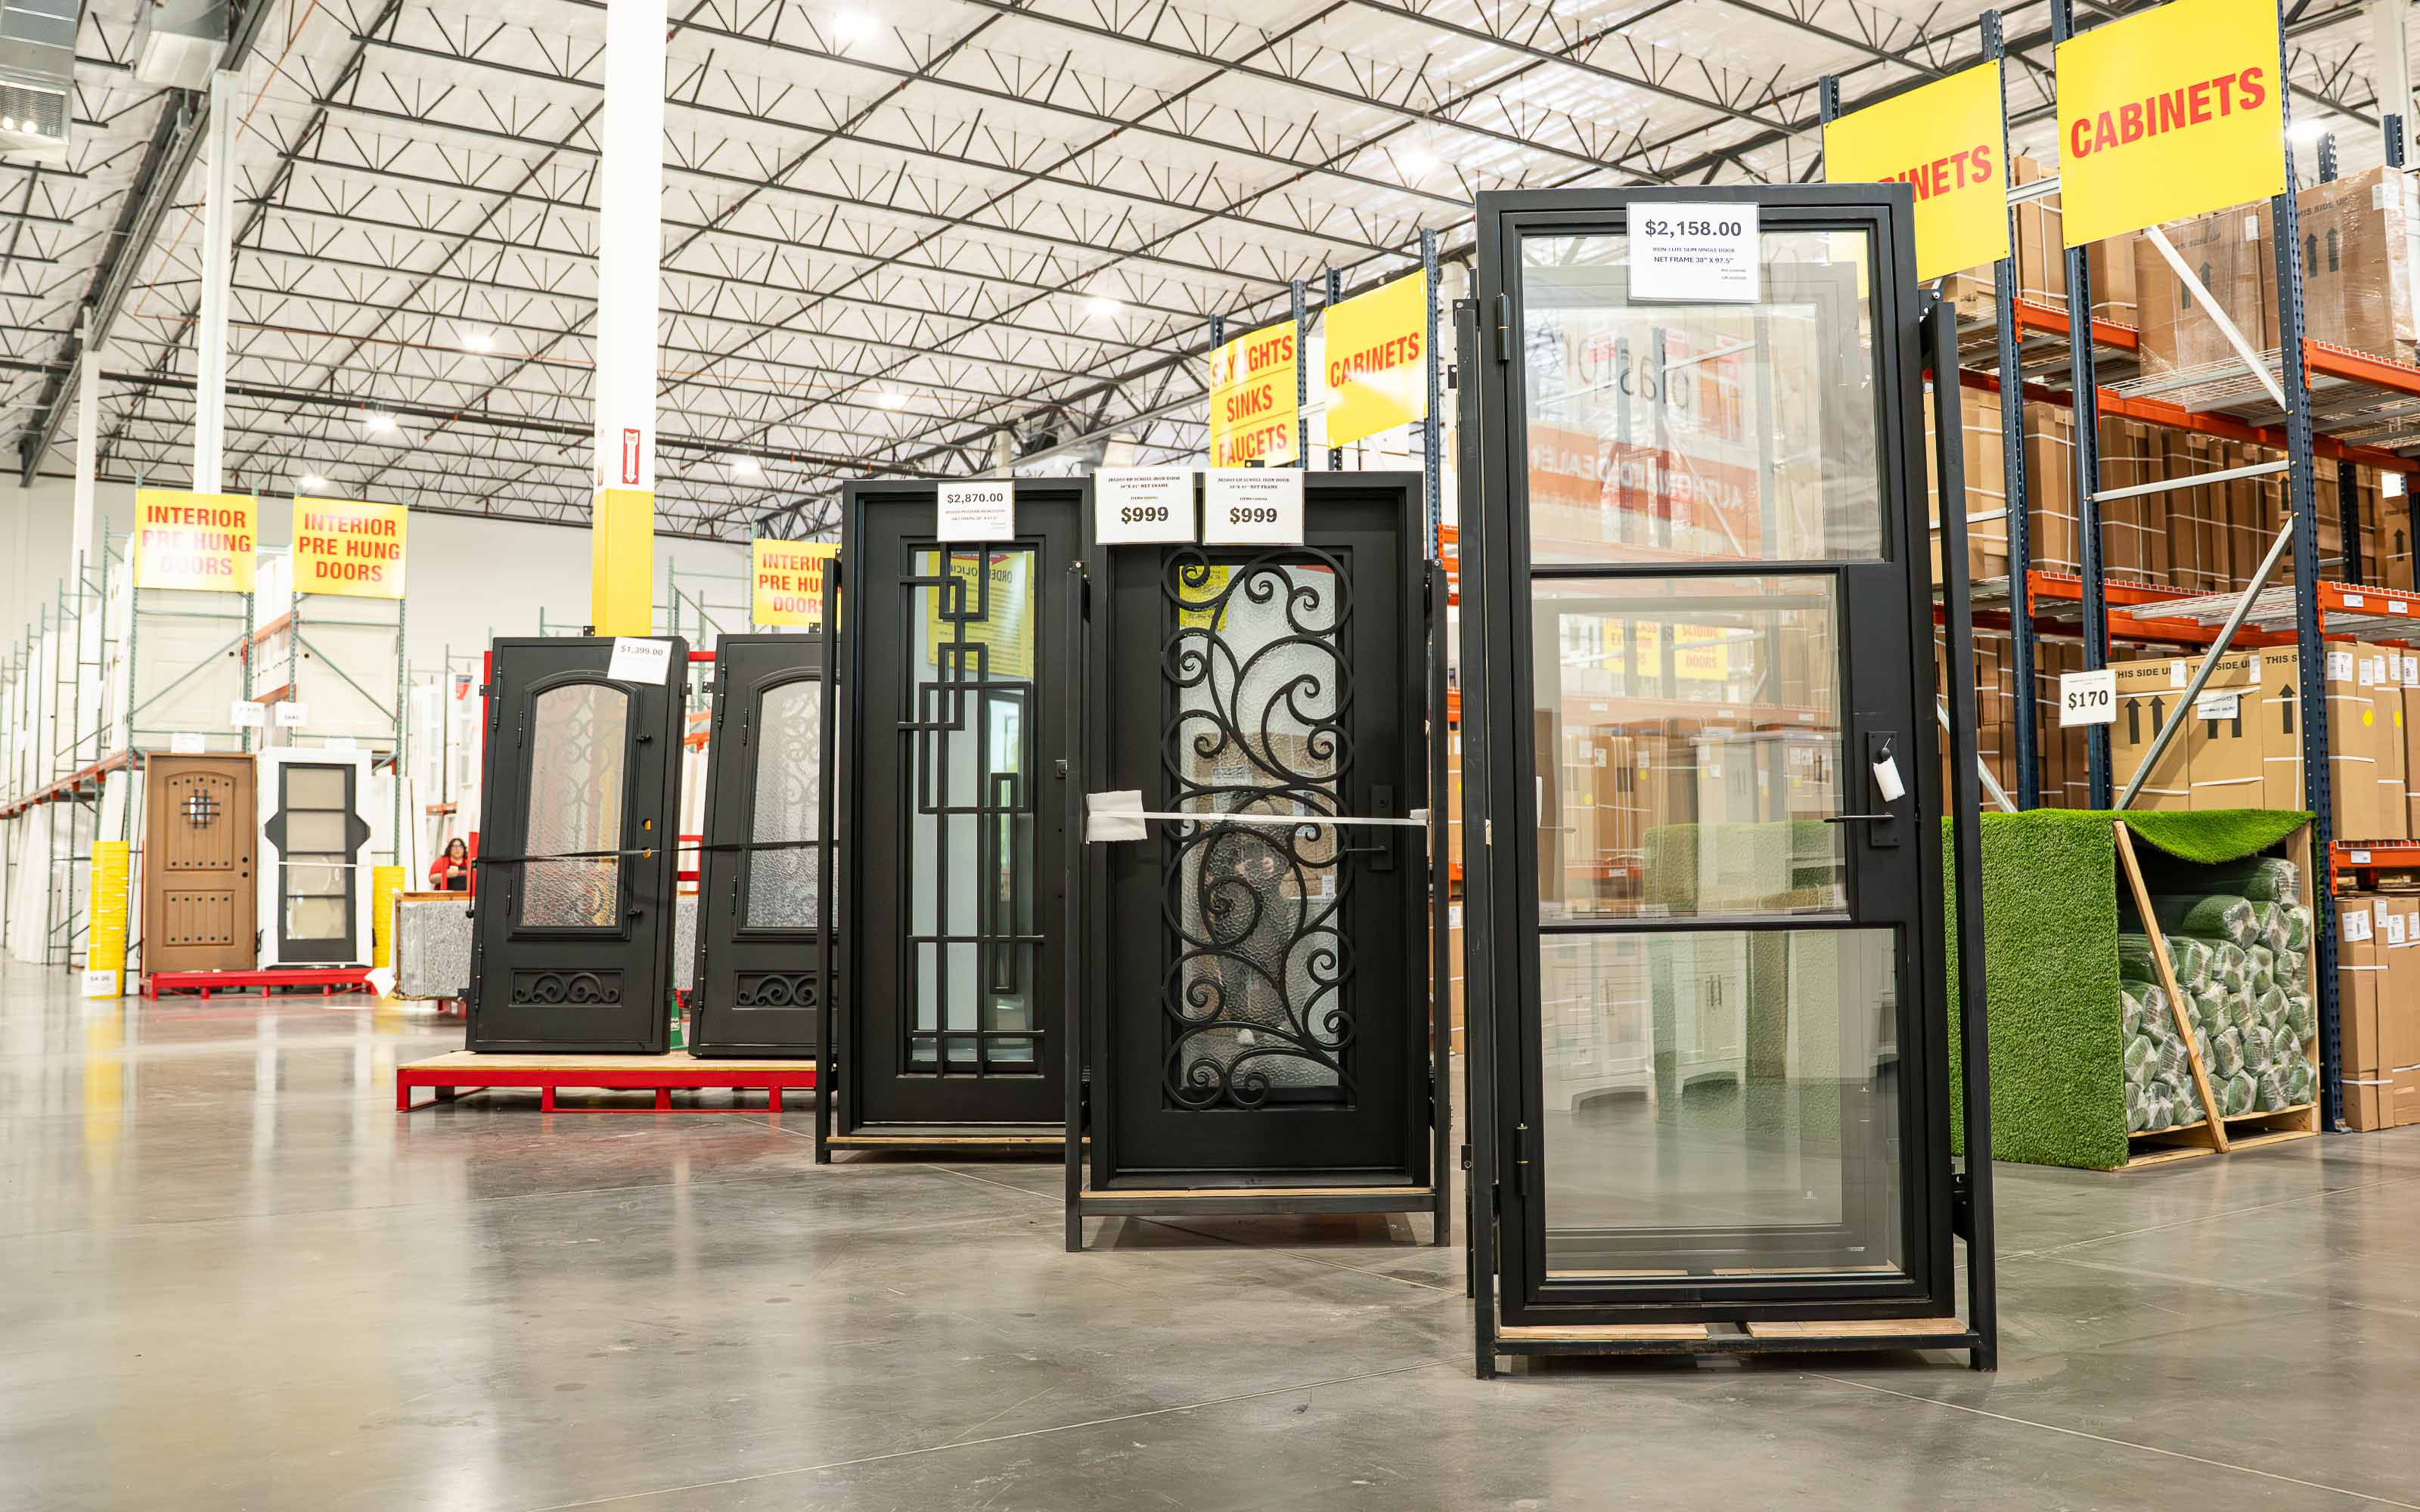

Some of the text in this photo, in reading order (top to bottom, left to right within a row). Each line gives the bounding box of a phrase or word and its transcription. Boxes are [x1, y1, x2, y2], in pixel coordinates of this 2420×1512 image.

[2071, 67, 2266, 159] CABINETS
[1877, 144, 1993, 203] NETS
[1645, 218, 1742, 238] $2,158.00
[1330, 332, 1419, 388] CABINETS
[1227, 384, 1273, 423] SINKS
[1219, 423, 1287, 467] FAUCETS
[947, 493, 1004, 504] $2,870.00
[147, 505, 247, 528] INTERIOR
[304, 513, 396, 537] INTERIOR
[1121, 507, 1168, 525] $999
[1230, 507, 1277, 525] $999
[194, 532, 251, 553] HUNG
[299, 536, 400, 560] PRE HUNG
[315, 561, 383, 582] DOORS
[762, 553, 824, 572] INTERIO
[759, 574, 824, 593] PRE HU
[774, 596, 824, 614] DOOR
[621, 645, 663, 656] $1,399.00
[2265, 655, 2288, 664] THIS
[2115, 666, 2171, 679] HIS SIDE U
[2216, 661, 2238, 671] SIDE
[2241, 659, 2251, 669] U
[2068, 689, 2108, 711] $170
